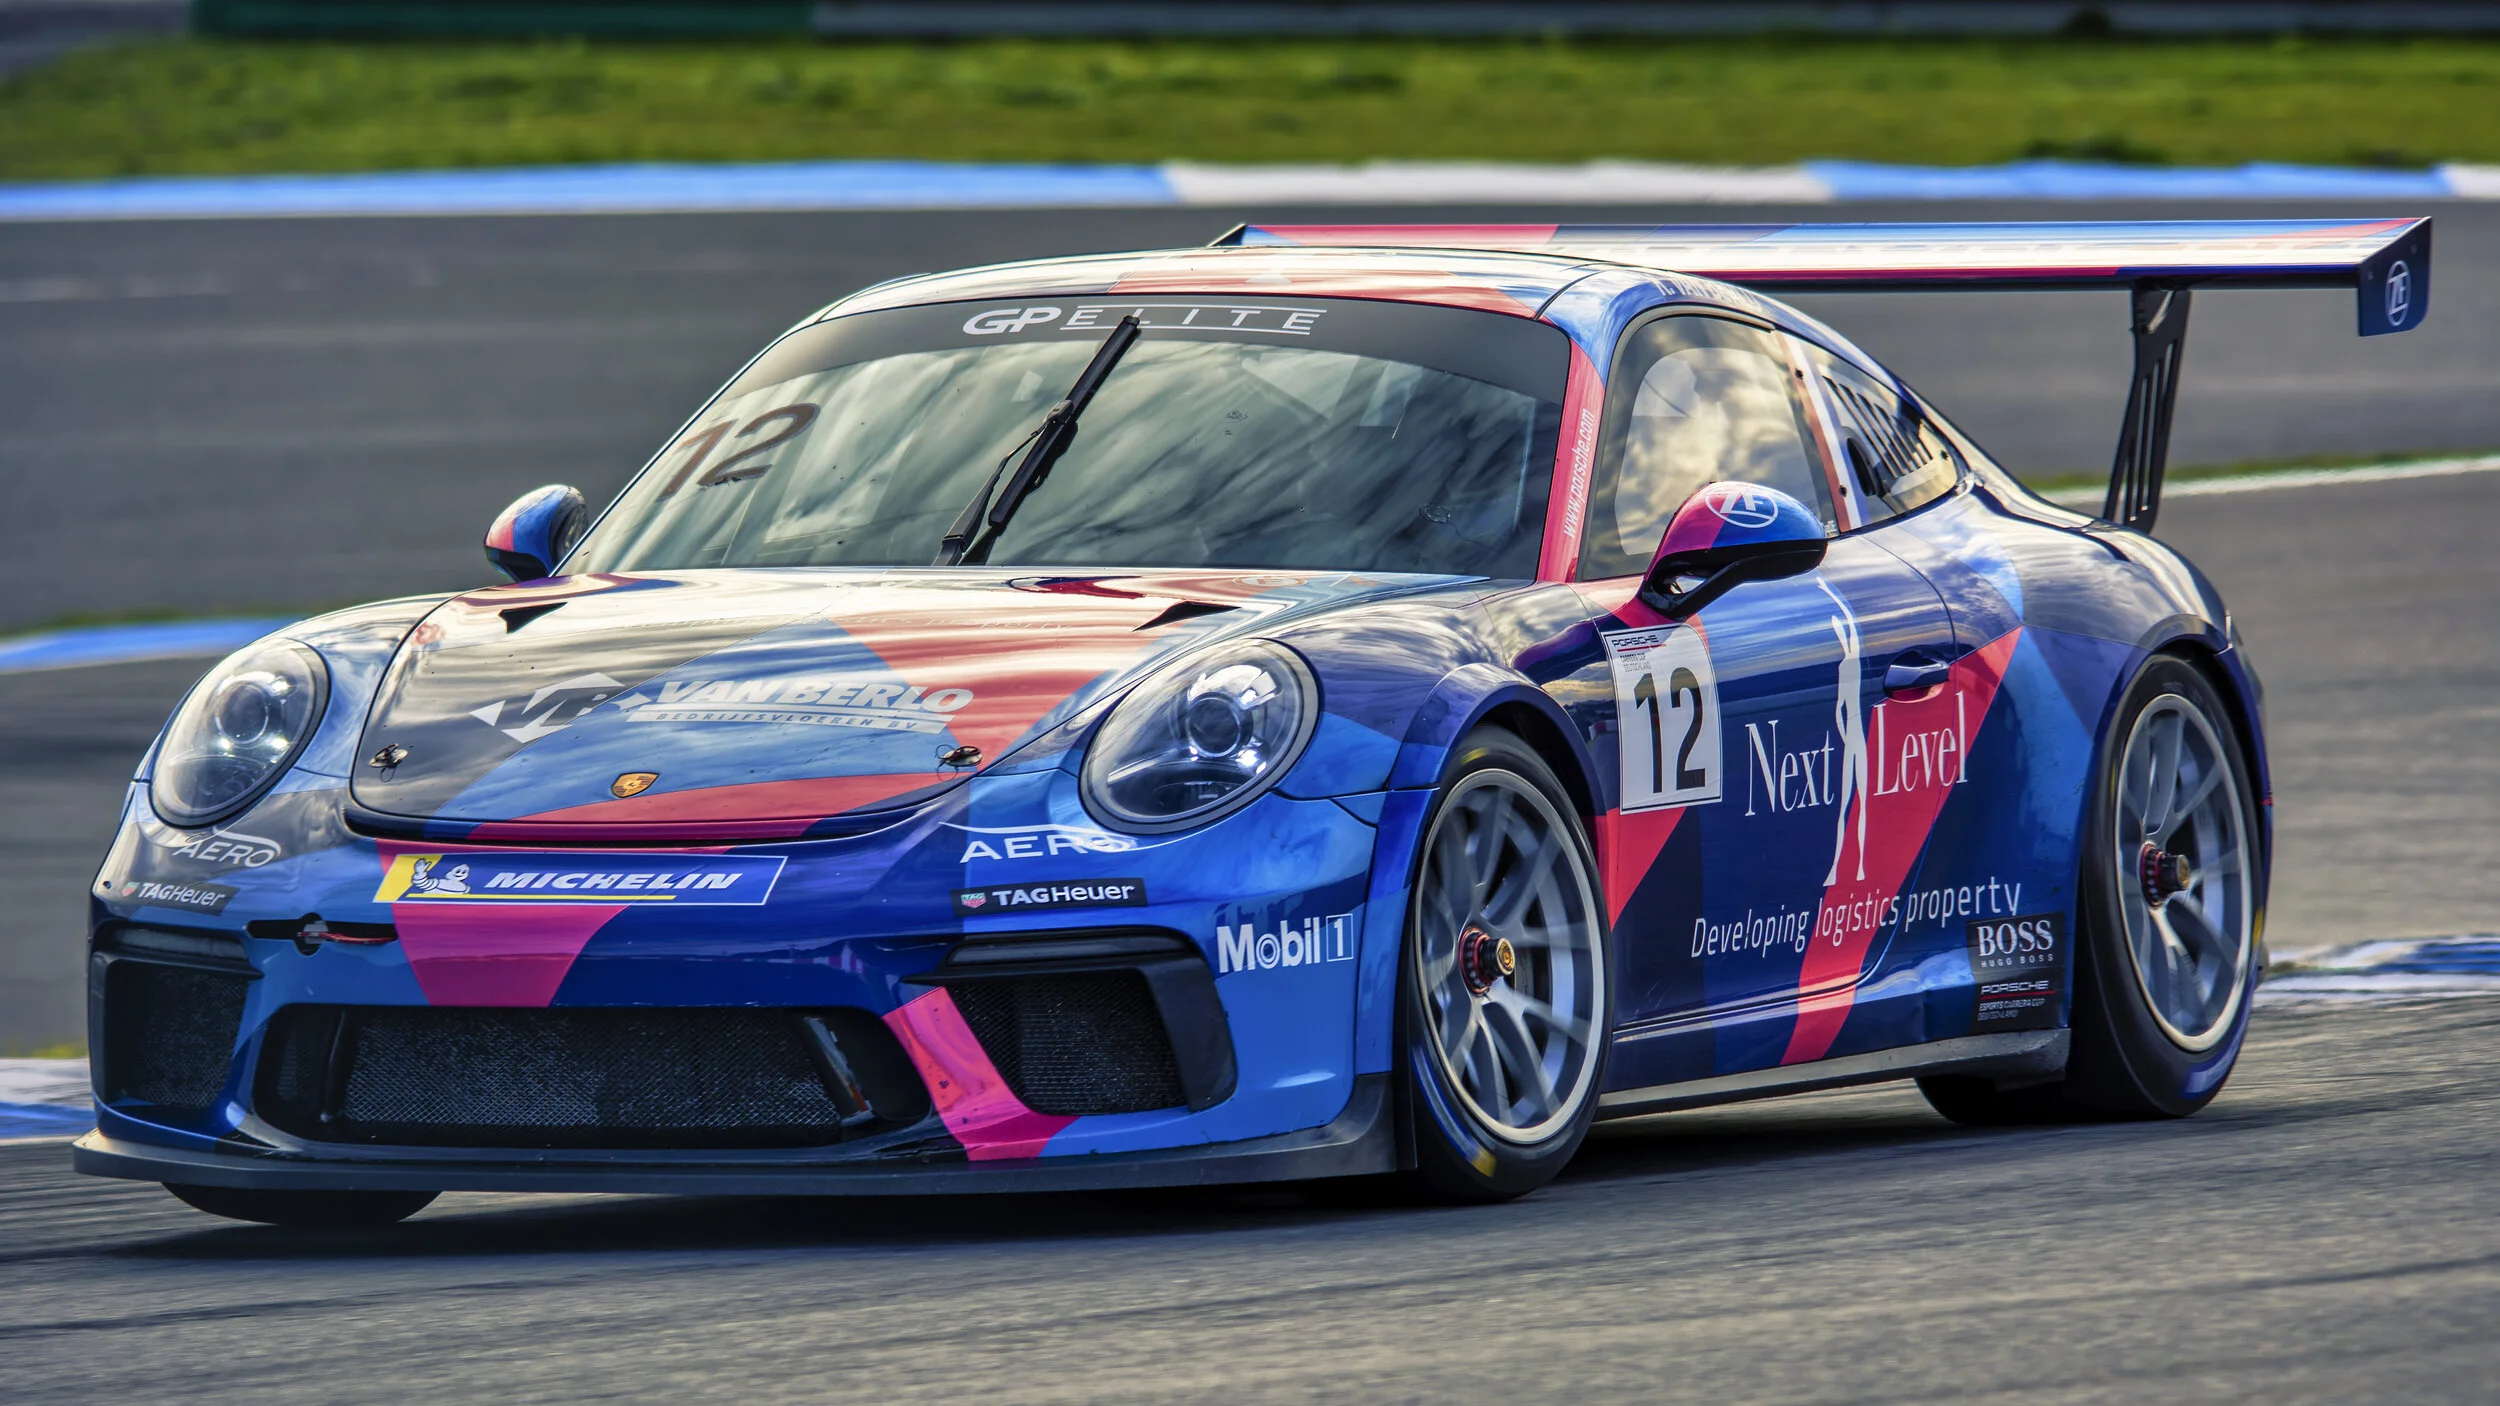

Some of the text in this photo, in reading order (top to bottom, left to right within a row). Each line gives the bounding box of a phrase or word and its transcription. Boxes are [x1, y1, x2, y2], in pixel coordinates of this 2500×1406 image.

[963, 307, 1321, 334] GP ELITE
[654, 402, 821, 502] 12
[1563, 408, 1596, 539] www.porsche.com
[1611, 634, 1659, 647] PORSCHE
[774, 681, 974, 713] BERLO
[656, 712, 917, 730] BEDRIJFSVLOEREN BV
[1634, 667, 1706, 793] 12
[1745, 690, 1968, 817] Next Level
[173, 841, 276, 868] AERO
[484, 872, 743, 891] MICHELIN
[1691, 876, 2021, 959] Developing logistics property
[1216, 916, 1321, 973] Mobil
[1977, 920, 2054, 957] BOSS
[1981, 953, 2054, 968] HUGO BOSS
[1980, 980, 2049, 995] PORSCHE
